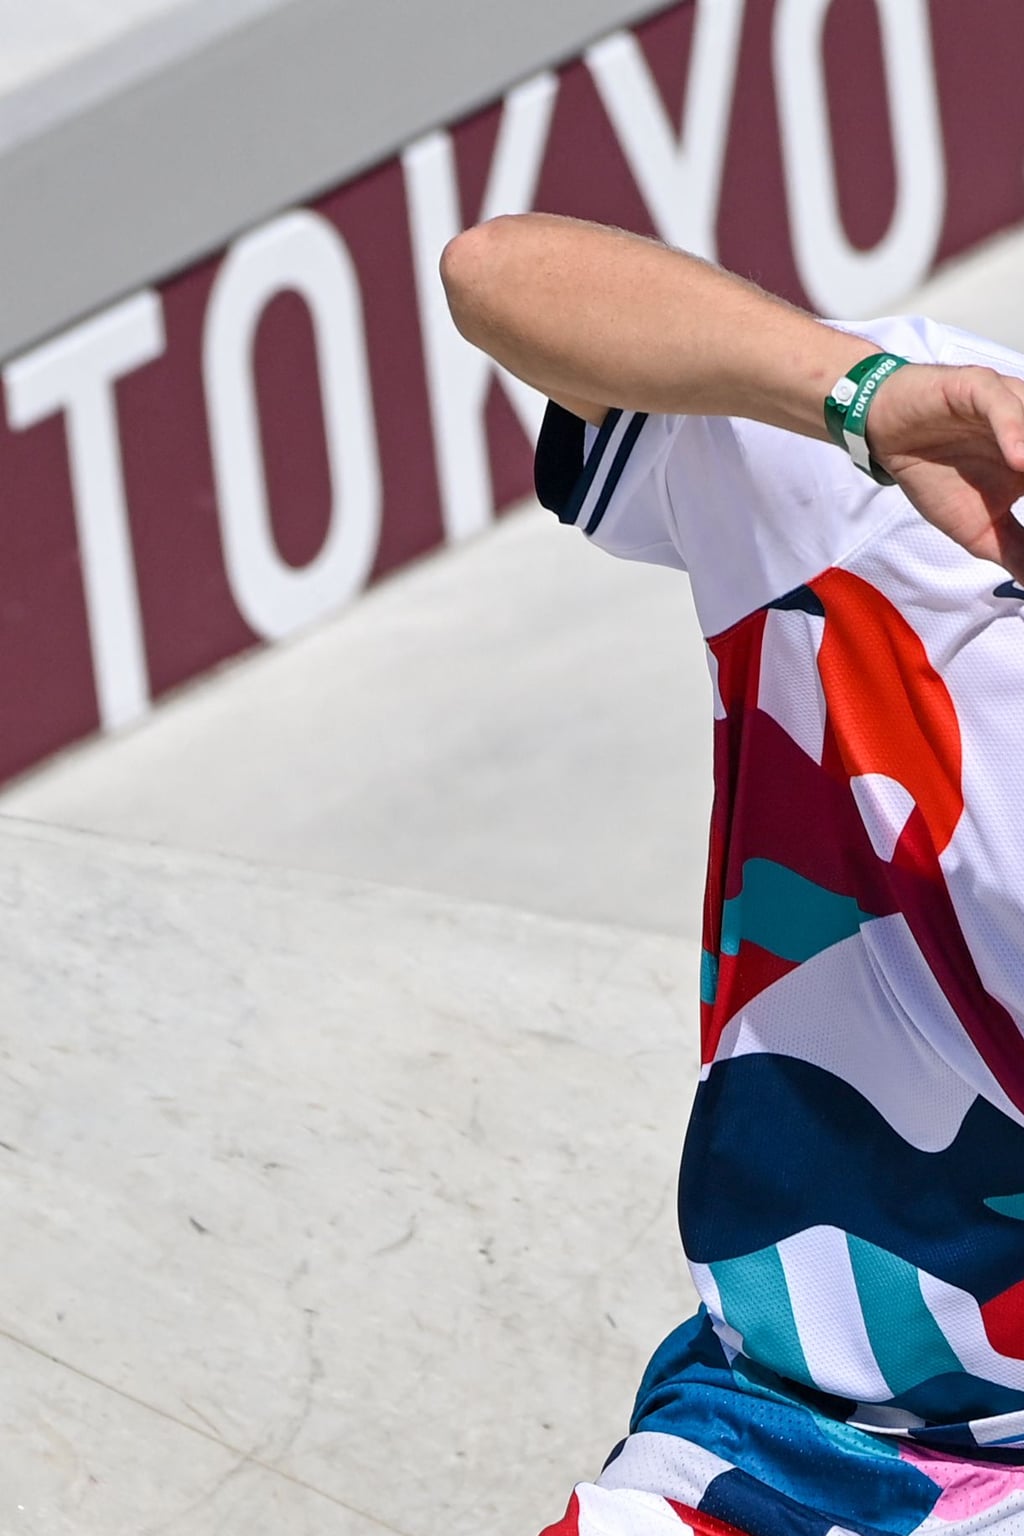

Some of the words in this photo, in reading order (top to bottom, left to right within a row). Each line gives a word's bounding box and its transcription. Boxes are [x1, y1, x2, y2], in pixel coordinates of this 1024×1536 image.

[3, 0, 944, 742] TOKYO
[852, 380, 876, 418] TOKYO
[871, 358, 897, 381] 2020
